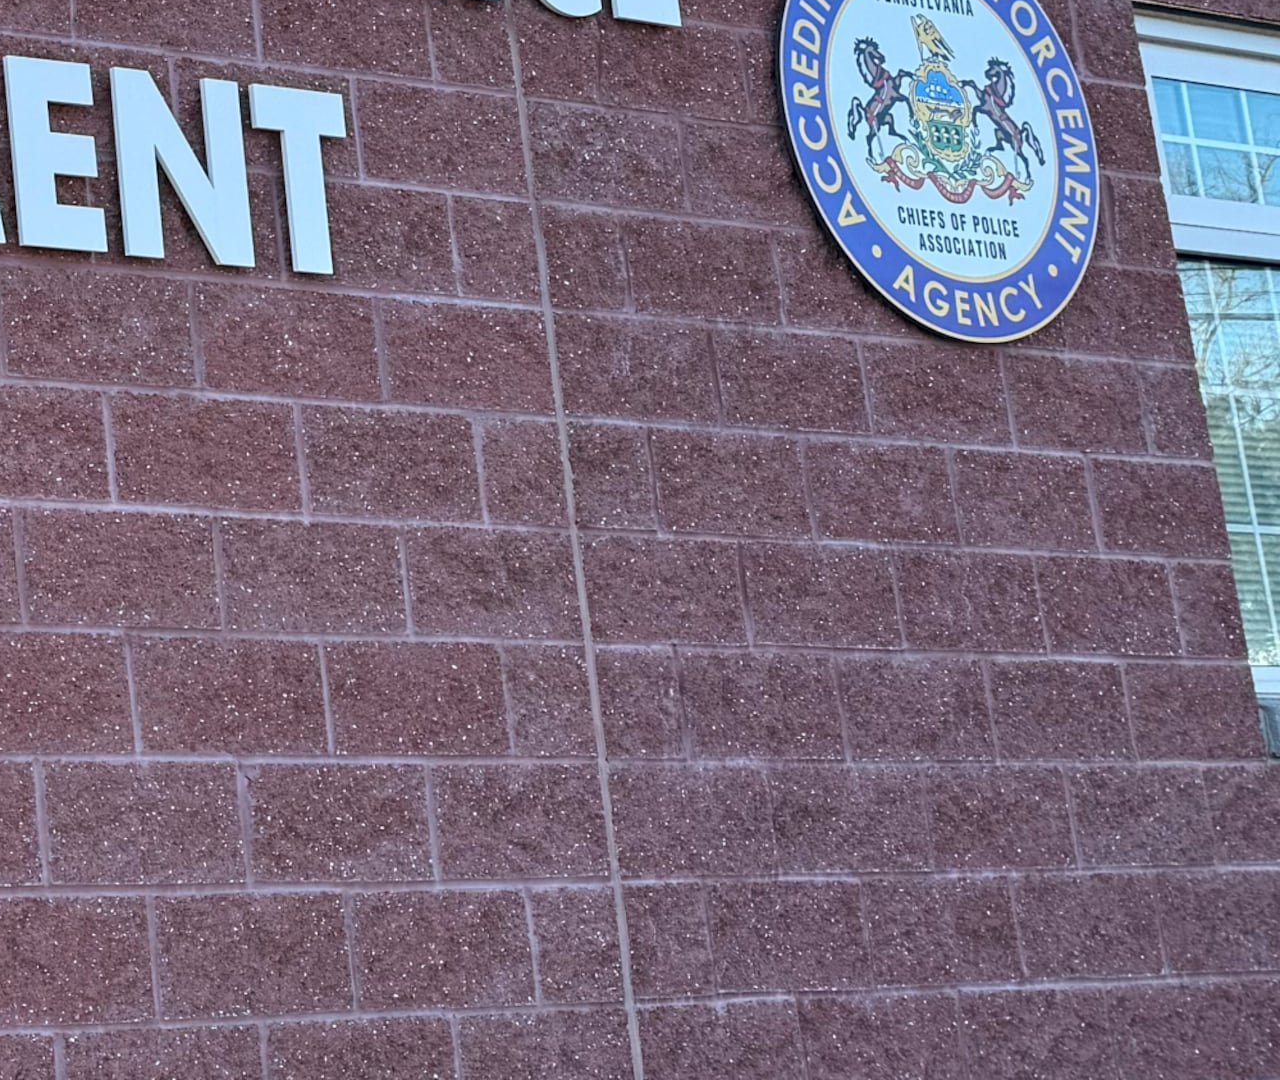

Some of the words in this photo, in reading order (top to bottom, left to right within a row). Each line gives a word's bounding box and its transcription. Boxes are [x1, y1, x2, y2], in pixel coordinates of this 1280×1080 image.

[897, 207, 946, 230] CHIEFS
[951, 213, 967, 232] OF
[973, 215, 1020, 238] POLICE
[919, 233, 1007, 260] ASSOCIATION
[893, 264, 1044, 327] AGENCY
